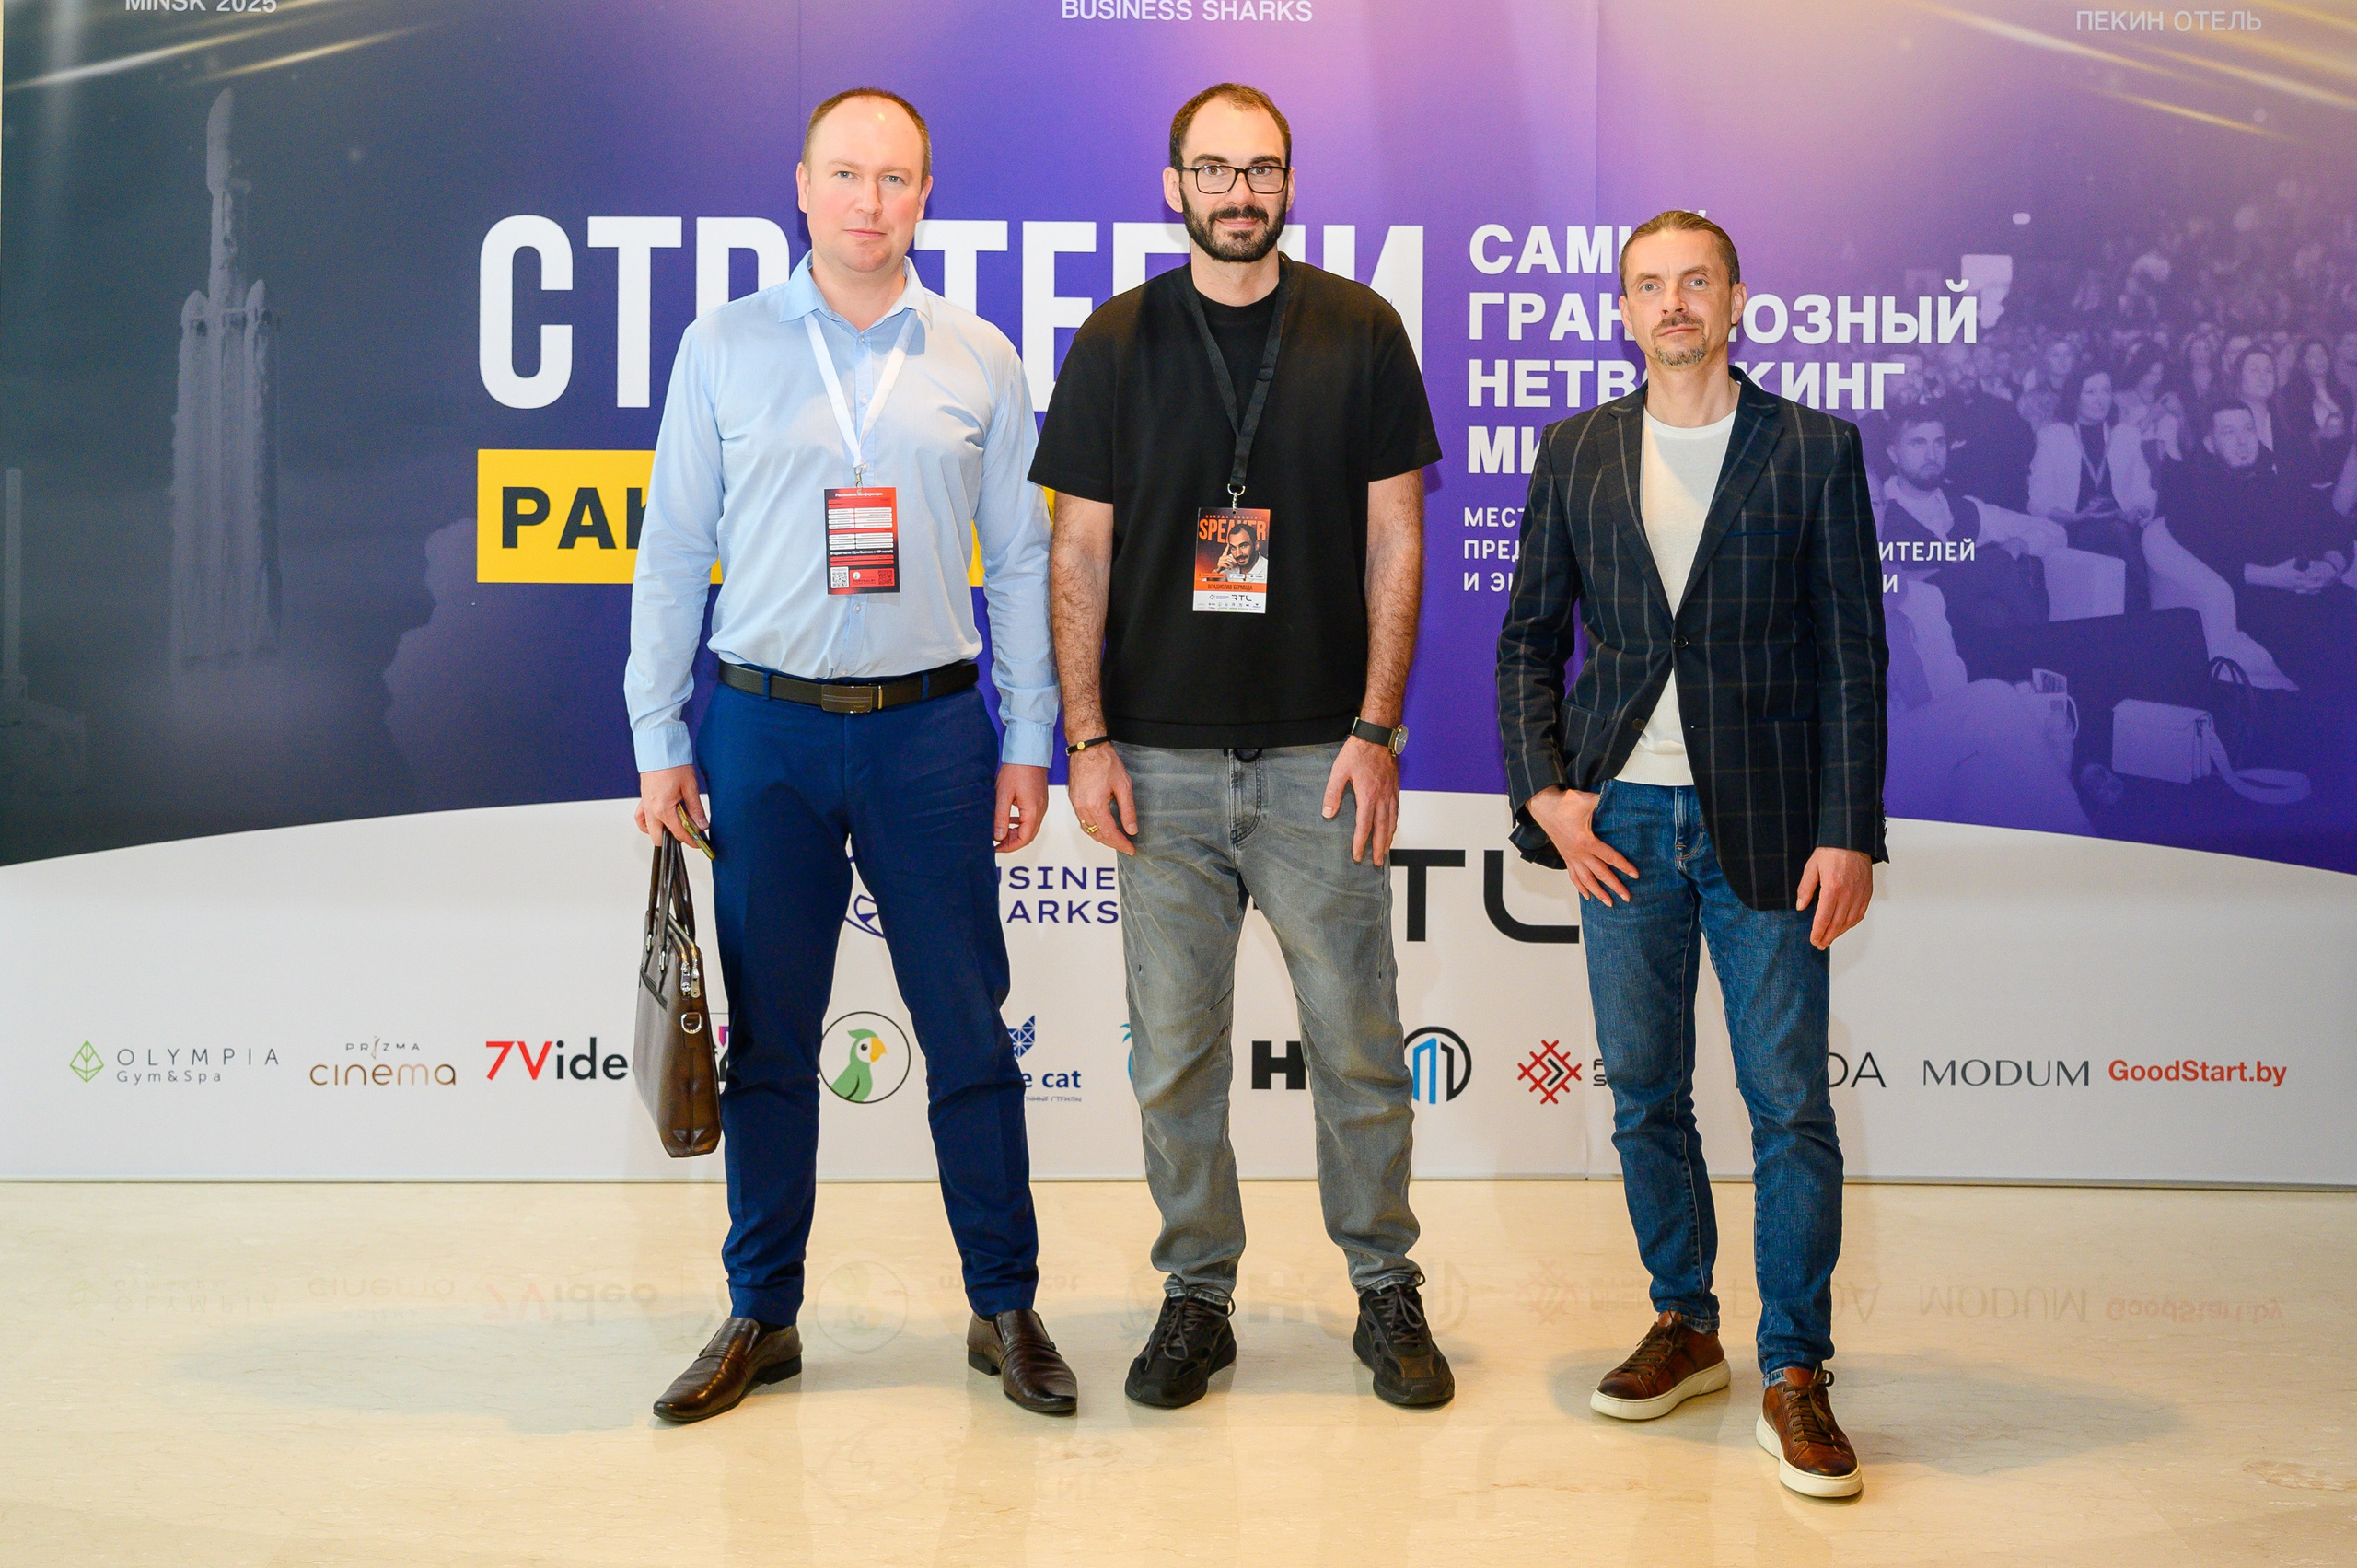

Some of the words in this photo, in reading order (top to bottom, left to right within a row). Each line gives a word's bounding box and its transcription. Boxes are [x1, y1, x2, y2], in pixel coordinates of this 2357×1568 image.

[125, 0, 206, 12] MINSK
[1062, 0, 1193, 21] BUSINESS
[1202, 0, 1313, 22] SHARKS
[2076, 10, 2164, 31] ПЕКИН
[2174, 10, 2262, 32] ОТЕЛЬ
[1469, 279, 1978, 344] ГРАНОЗНЫЙ
[1464, 507, 1525, 528] МЕС
[1463, 572, 1480, 592] И
[1231, 594, 1252, 602] RTL
[117, 1048, 279, 1066] OLYMPIA
[485, 1037, 630, 1081] 7Vide
[117, 1070, 222, 1086] Gym&Spa
[309, 1063, 456, 1086] cinema
[1041, 1070, 1082, 1088] cat
[1922, 1059, 2090, 1086] MODUM
[2108, 1060, 2287, 1087] GoodStart.by
